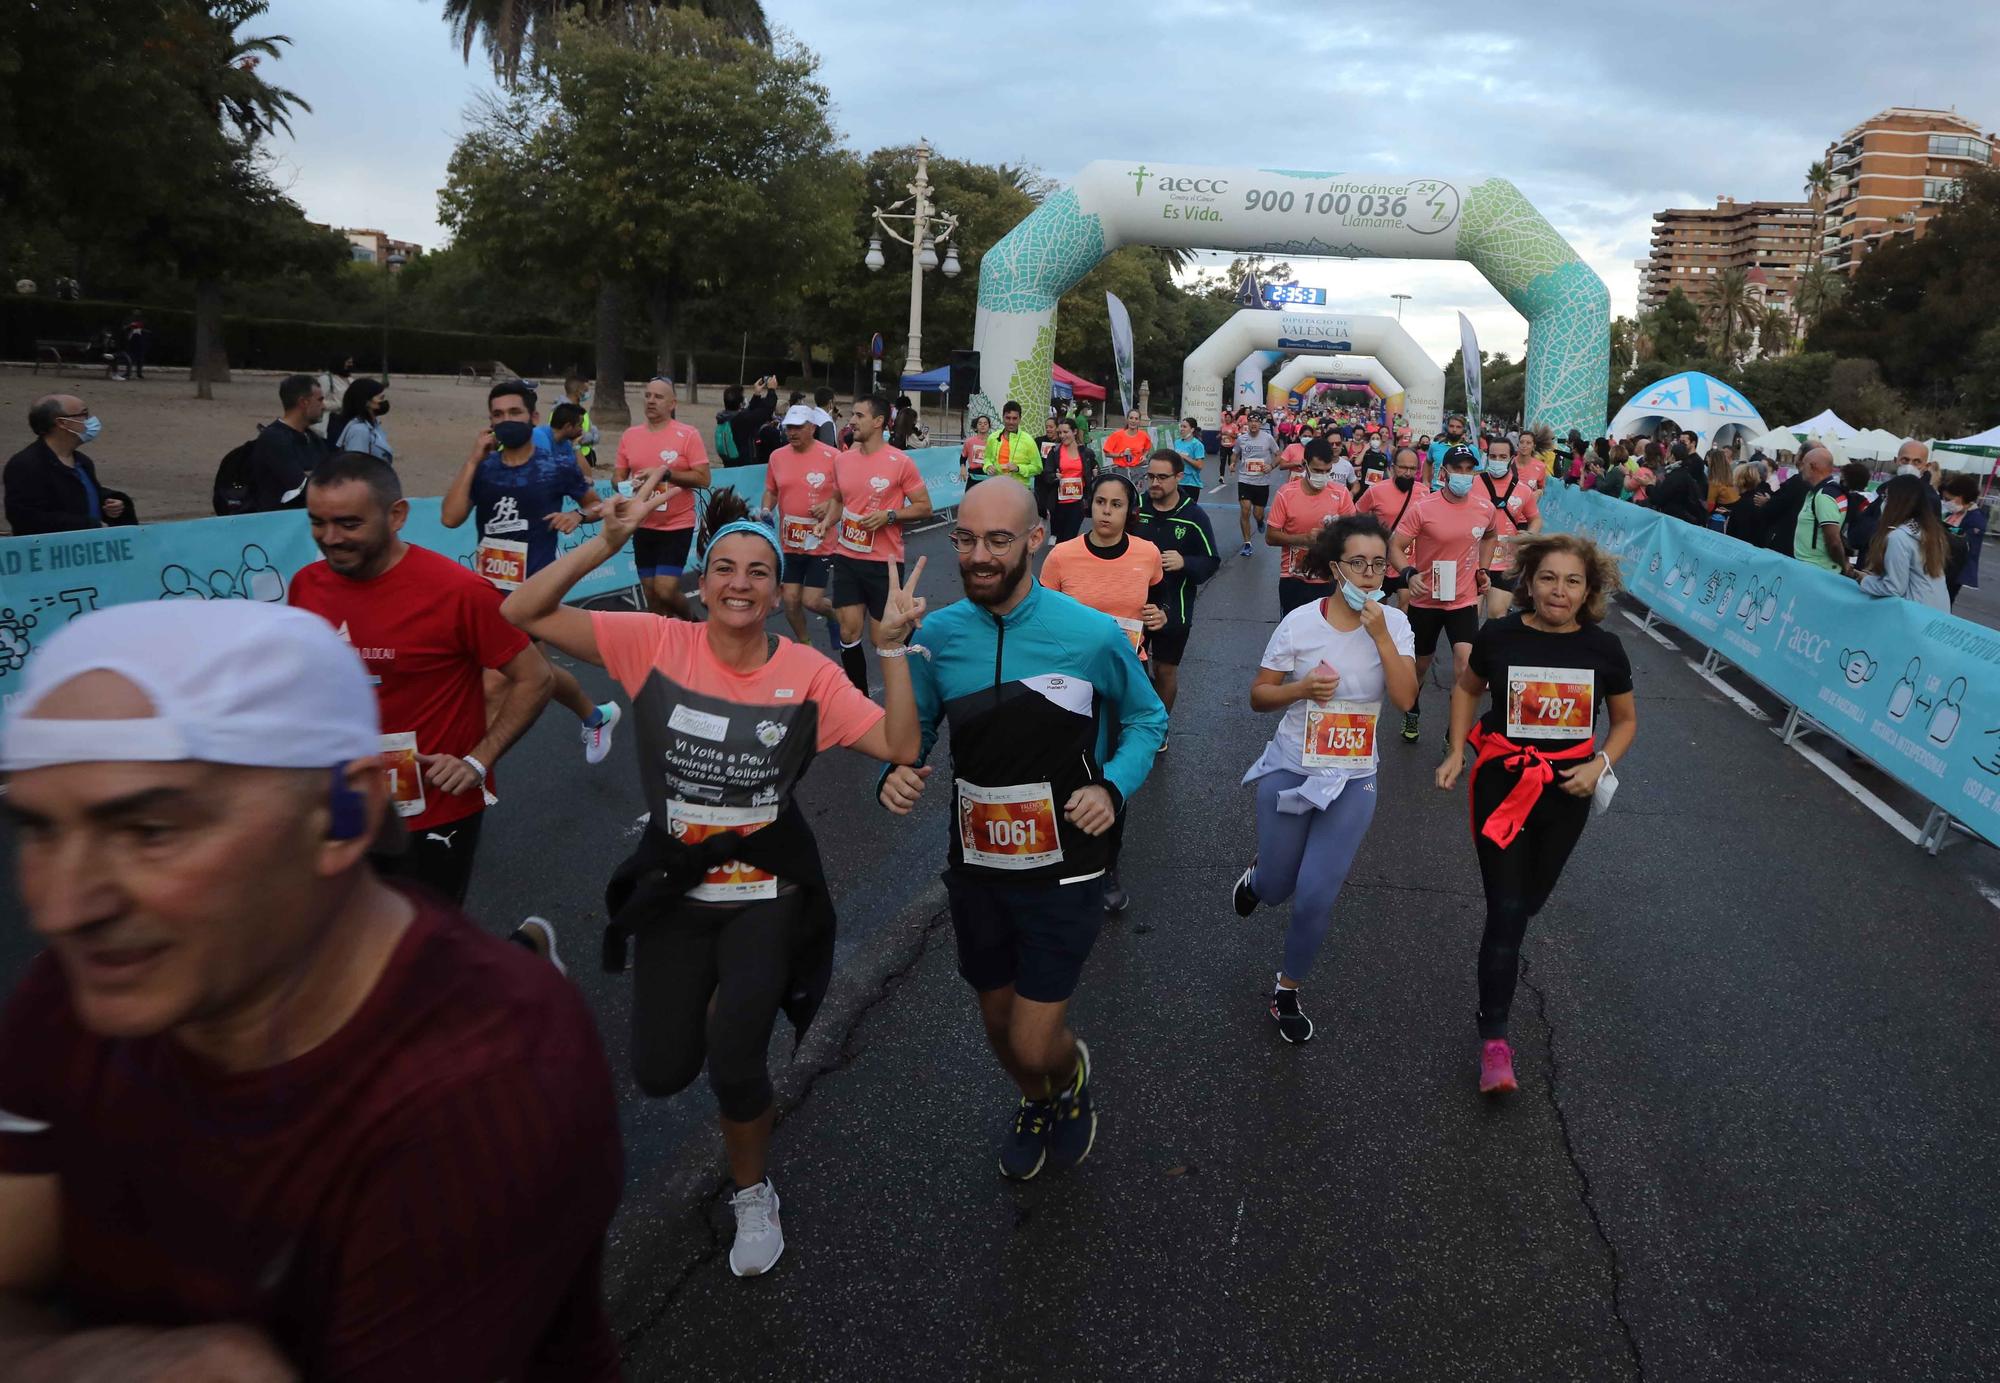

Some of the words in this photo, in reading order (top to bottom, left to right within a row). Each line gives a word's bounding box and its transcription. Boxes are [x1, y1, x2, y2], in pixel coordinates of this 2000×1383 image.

[1158, 176, 1229, 194] aecc
[1329, 182, 1410, 196] infocáncer
[1416, 183, 1437, 193] 24
[1163, 204, 1180, 219] Es
[1184, 205, 1223, 222] Vida.
[1244, 189, 1295, 213] 900
[1303, 191, 1352, 216] 100
[1357, 194, 1408, 218] 036
[1432, 202, 1446, 220] 7
[1342, 214, 1405, 229] Llámame.
[846, 526, 867, 542] 1629
[49, 538, 134, 570] HIGIENE
[486, 557, 519, 577] 2005
[1788, 626, 1831, 664] aecc
[1538, 696, 1576, 720] 787
[1327, 726, 1367, 750] 1353
[665, 750, 721, 774] Caminata
[725, 765, 780, 779] Solidaria
[690, 744, 723, 761] Volta
[740, 752, 765, 765] Peu
[986, 819, 1037, 847] 1061
